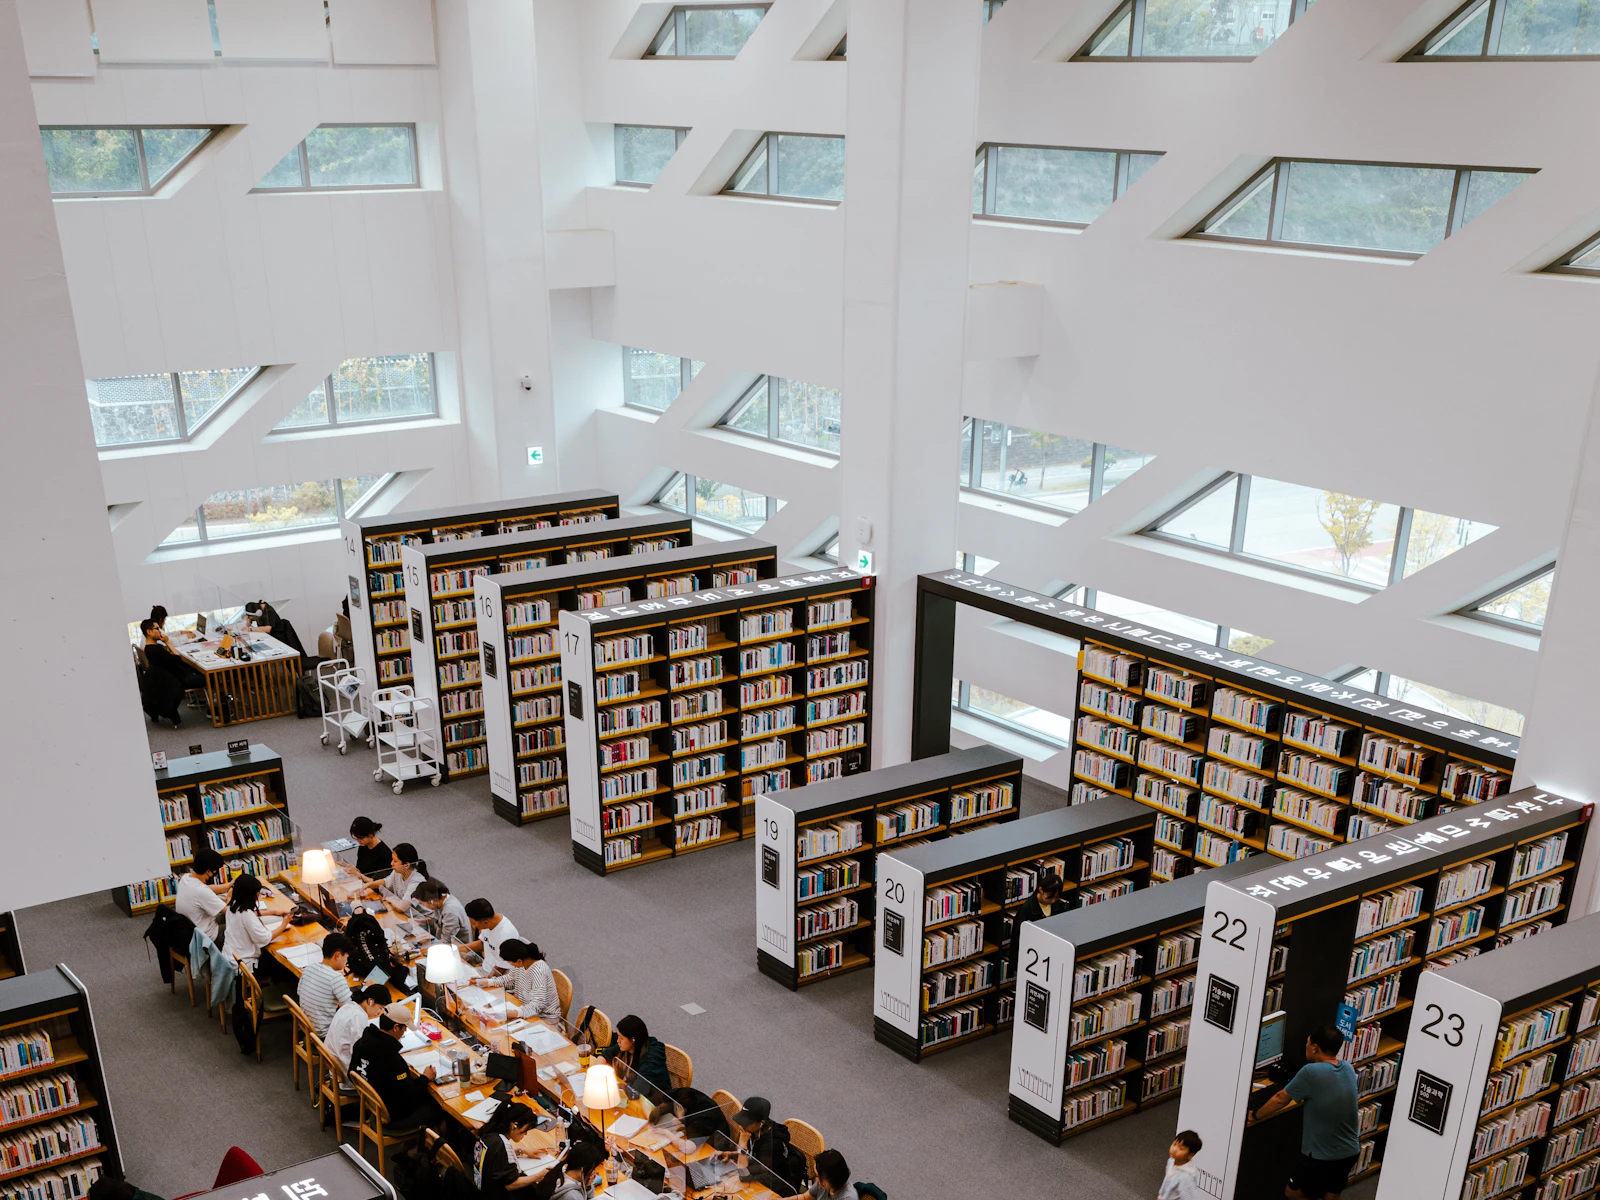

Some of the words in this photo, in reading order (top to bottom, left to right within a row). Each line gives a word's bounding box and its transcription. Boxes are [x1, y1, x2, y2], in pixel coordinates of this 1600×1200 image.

[344, 536, 356, 556] 14
[406, 564, 419, 586] 15
[479, 594, 493, 618] 16
[564, 631, 579, 655] 17
[764, 817, 779, 841] 19
[885, 878, 905, 904] 20
[1211, 910, 1247, 951] 22
[1025, 947, 1050, 982] 21
[1339, 1019, 1352, 1030] 도서
[1420, 1003, 1465, 1047] 23
[1420, 1083, 1443, 1100] 기술과학
